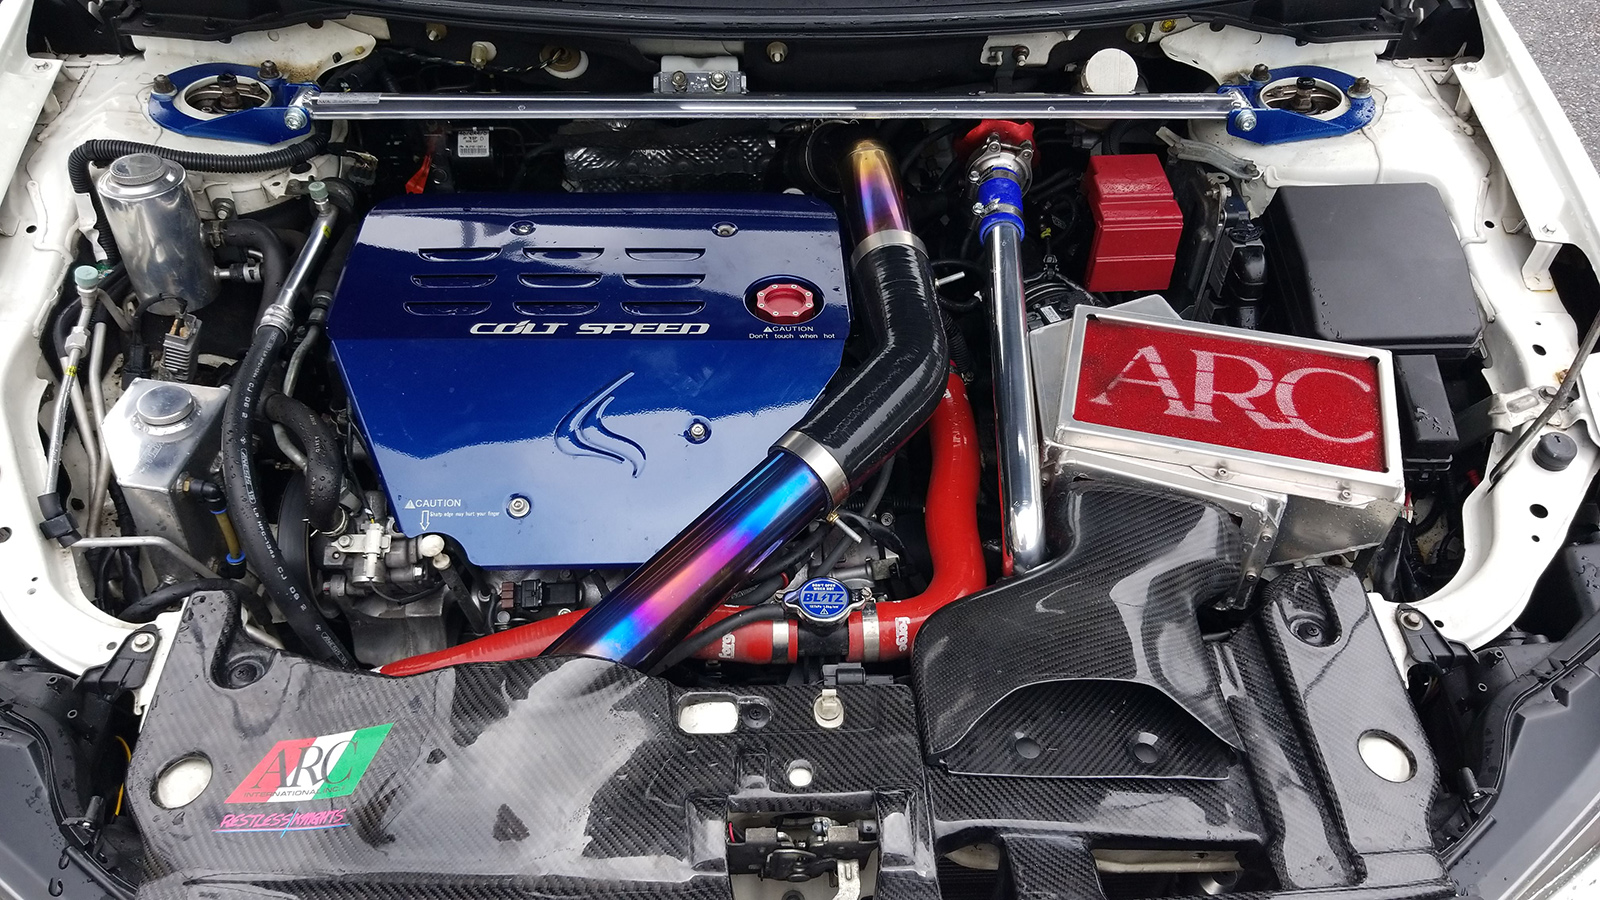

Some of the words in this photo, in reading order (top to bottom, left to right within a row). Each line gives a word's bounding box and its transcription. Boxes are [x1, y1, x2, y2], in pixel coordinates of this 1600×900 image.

[470, 319, 569, 335] COLT
[576, 322, 711, 335] SPEED
[1089, 345, 1374, 444] ARC
[415, 499, 462, 508] CAUTION
[803, 592, 845, 603] BLITZ
[249, 740, 359, 789] ARC
[244, 788, 322, 798] INTERNATIONAL
